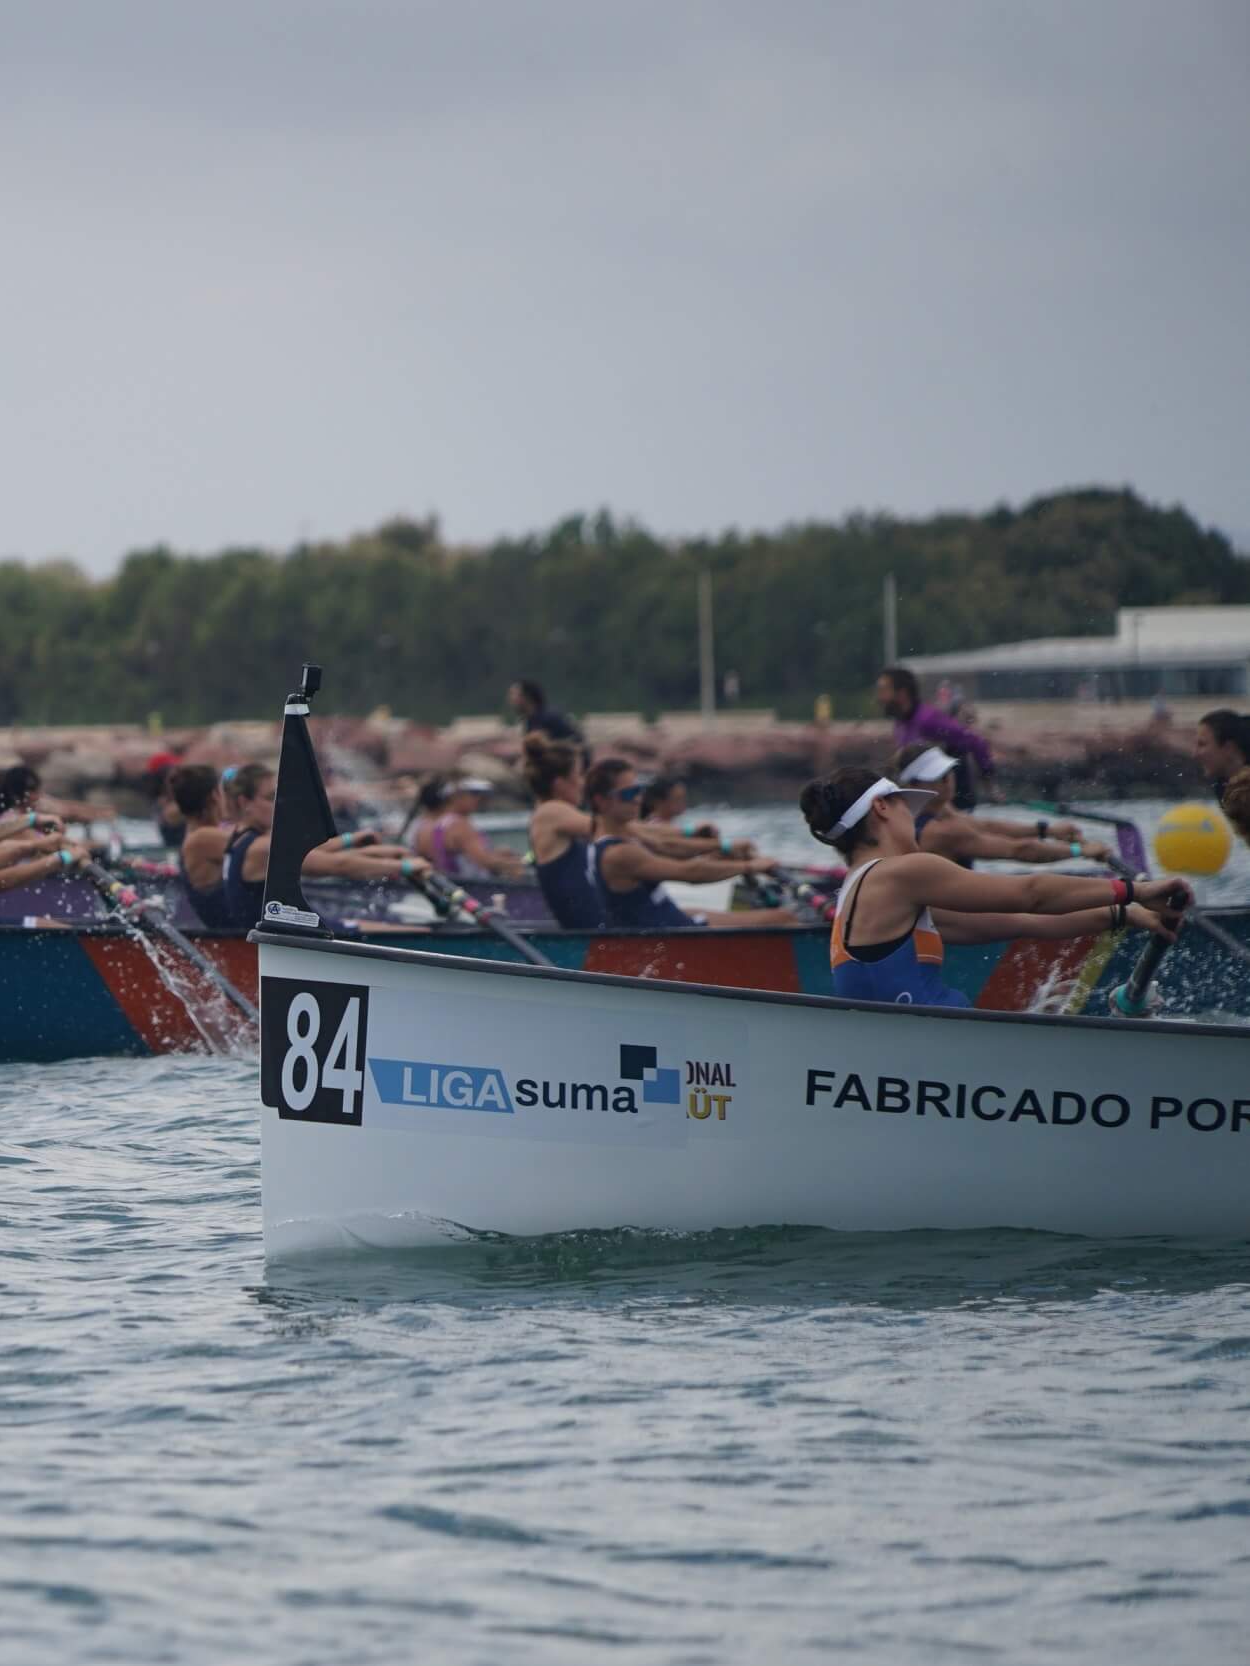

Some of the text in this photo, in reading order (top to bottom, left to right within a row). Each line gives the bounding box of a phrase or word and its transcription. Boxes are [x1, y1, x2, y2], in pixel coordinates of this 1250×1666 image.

[281, 991, 362, 1114] 84
[402, 1067, 638, 1113] LIGA suma
[686, 1087, 732, 1121] ÜT
[806, 1069, 1130, 1128] FABRICADO
